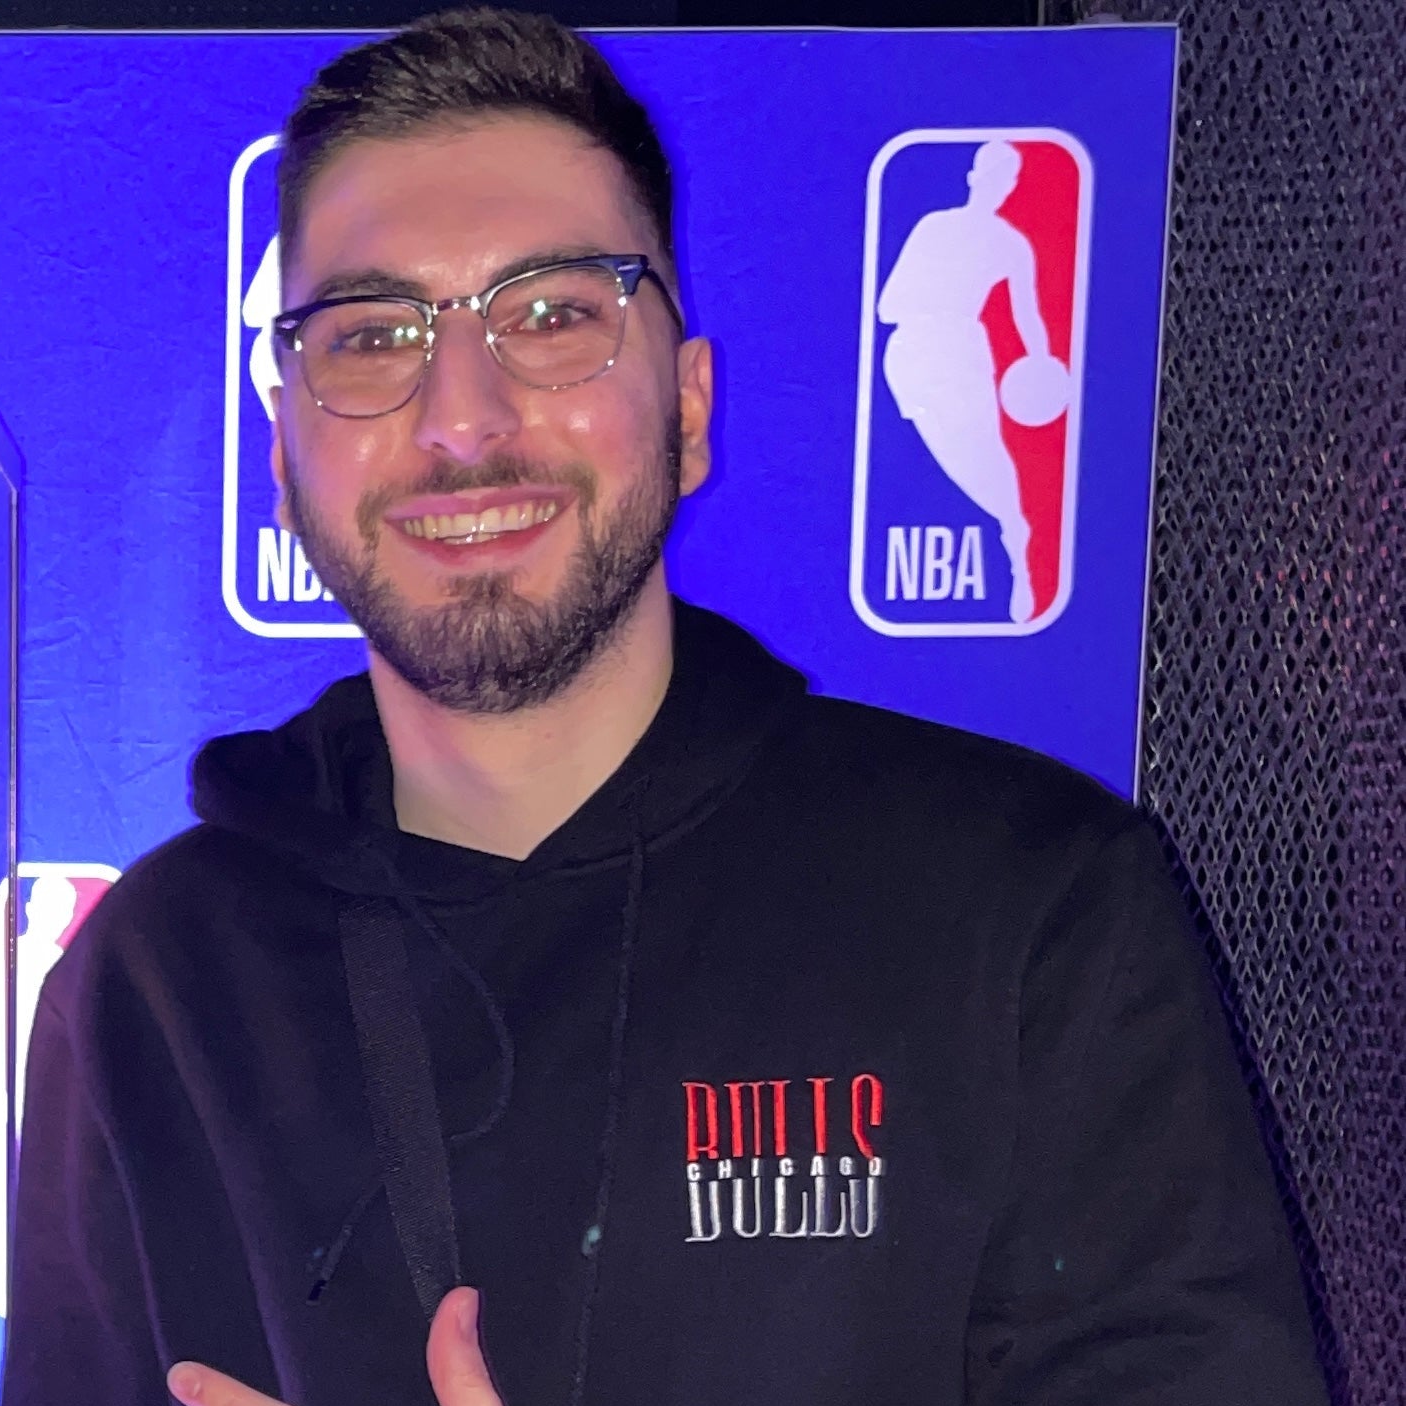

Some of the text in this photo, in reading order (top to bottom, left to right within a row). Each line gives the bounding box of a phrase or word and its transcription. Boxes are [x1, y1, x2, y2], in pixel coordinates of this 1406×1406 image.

[257, 527, 335, 602] NB
[885, 526, 986, 601] NBA
[686, 1156, 885, 1182] CHICAGO
